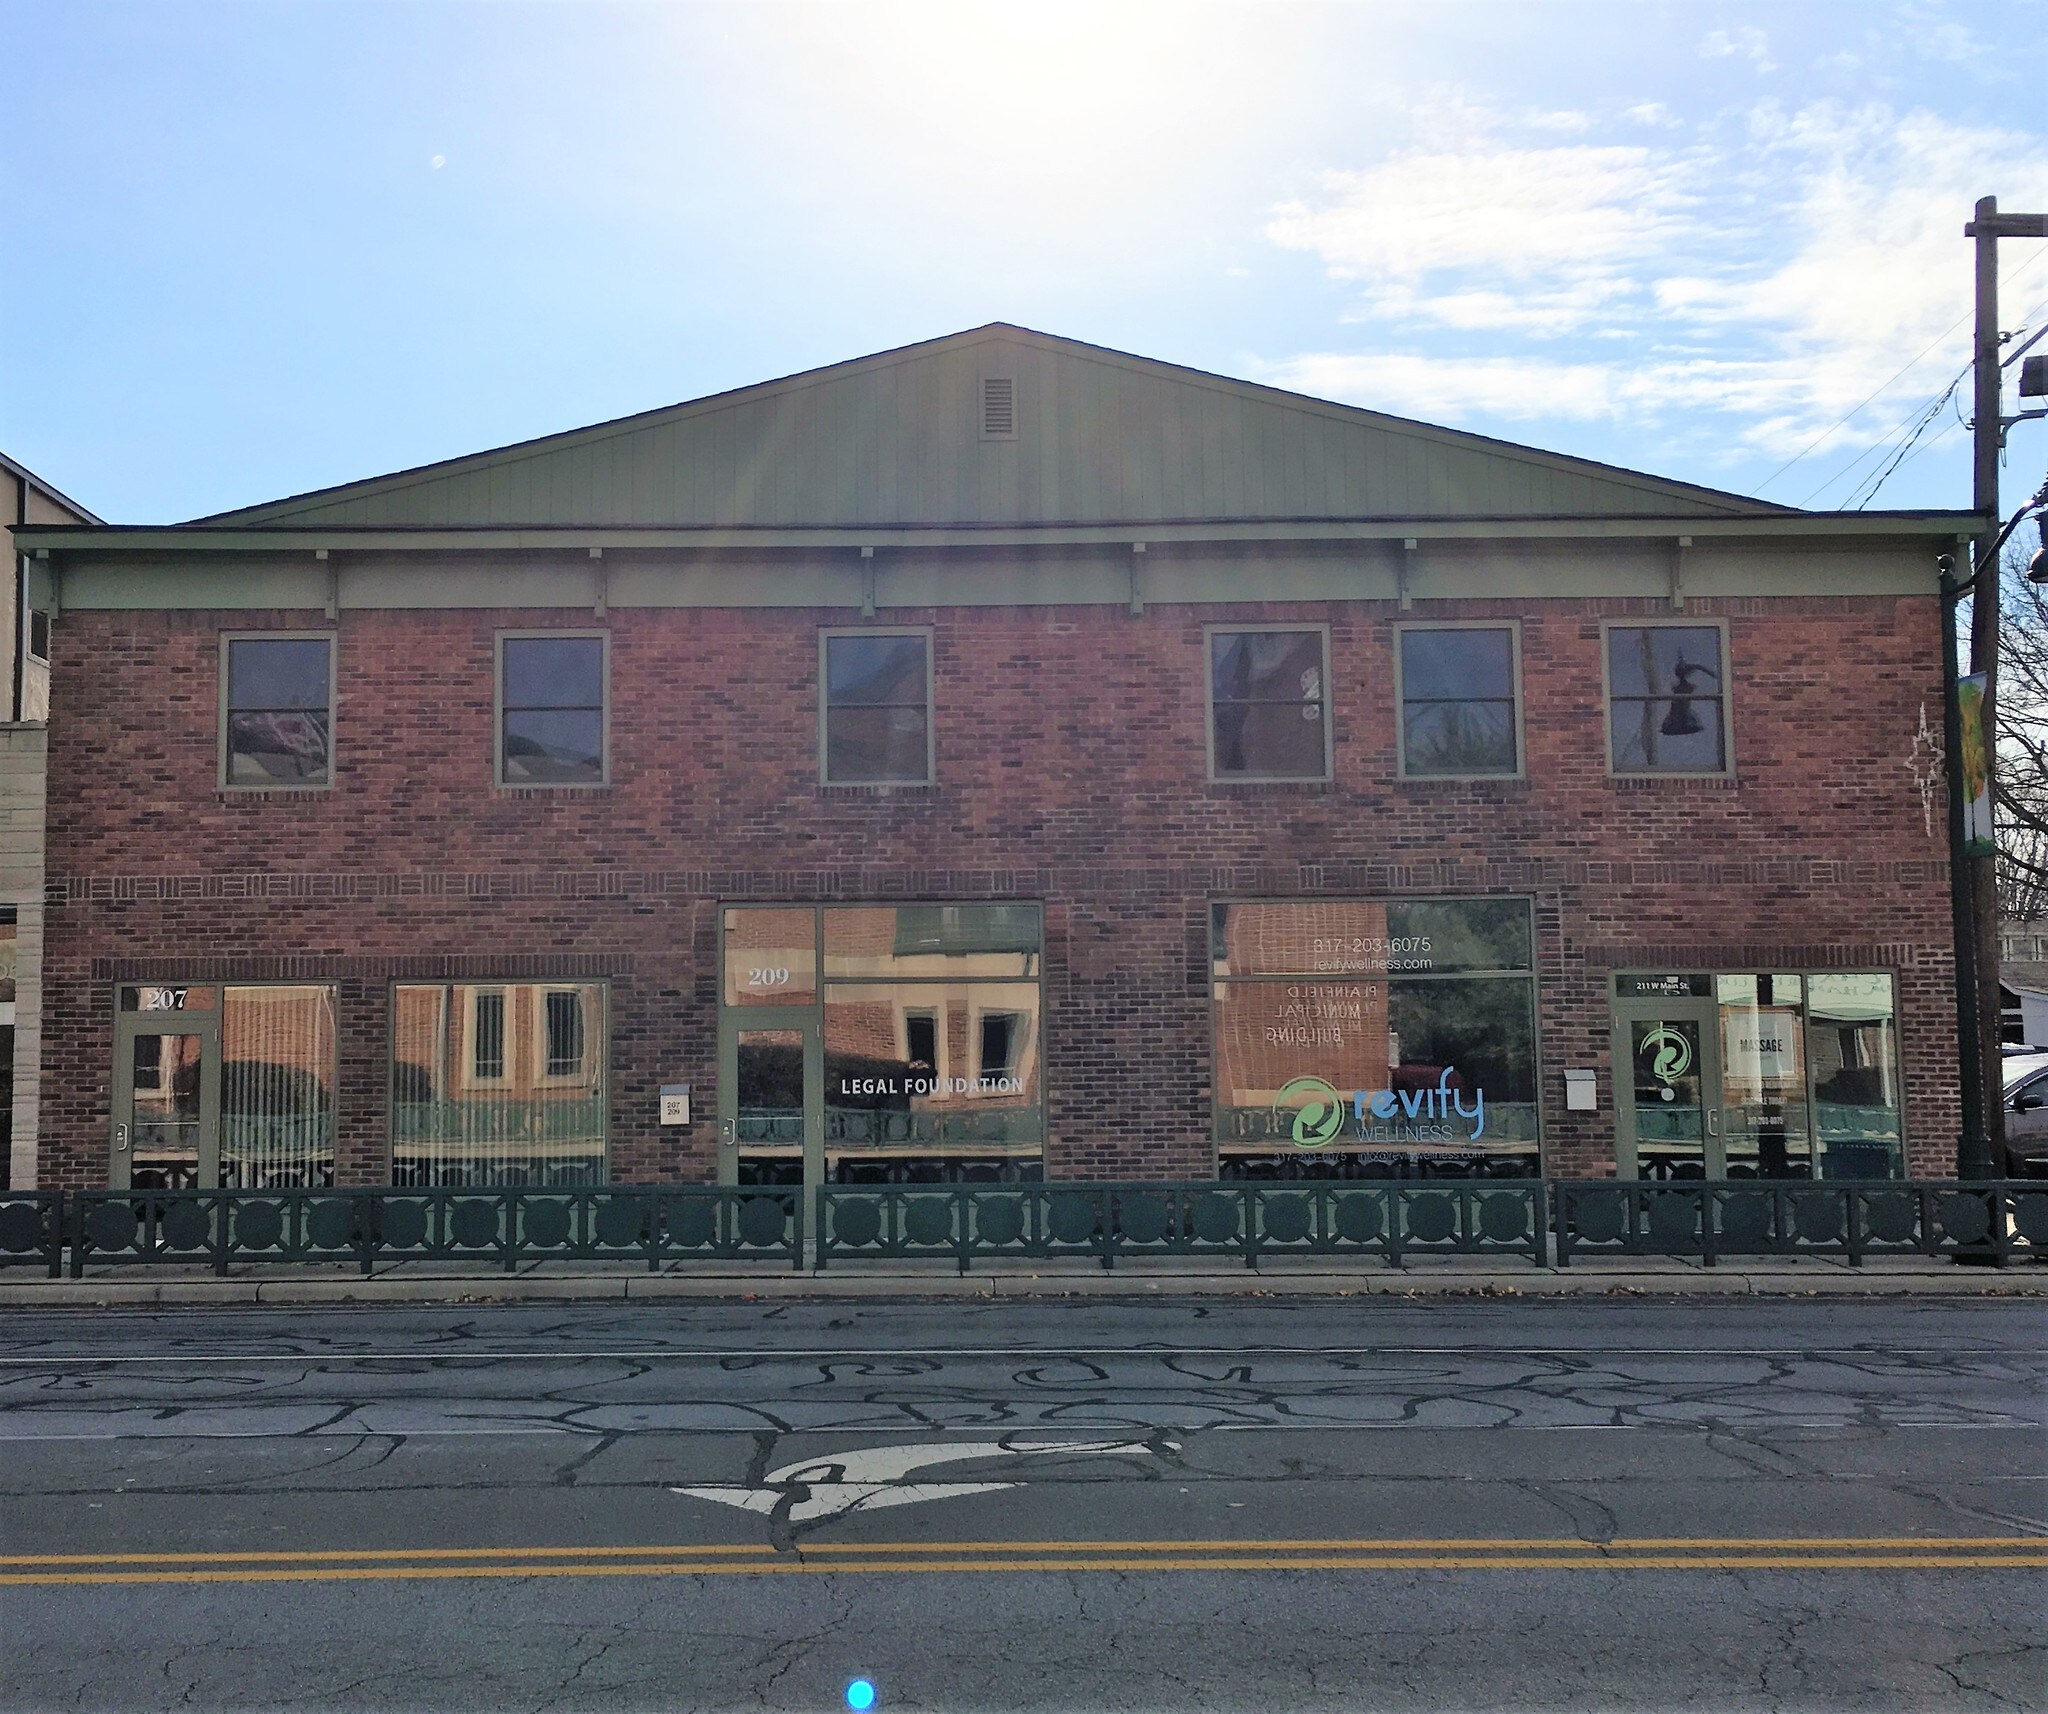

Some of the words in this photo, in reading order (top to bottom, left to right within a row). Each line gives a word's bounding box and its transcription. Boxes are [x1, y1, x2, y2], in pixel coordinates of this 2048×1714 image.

[1313, 937, 1432, 953] 317-203-6075
[1313, 957, 1433, 973] revifywellness.com
[748, 967, 790, 986] 209
[1636, 982, 1651, 990] 211
[1651, 982, 1660, 990] W
[1660, 982, 1679, 990] Main
[146, 990, 188, 1009] 207
[1740, 1039, 1783, 1052] MASSAGE
[841, 1078, 898, 1095] LEGAL
[904, 1077, 1024, 1094] FOUNDATION
[666, 1101, 681, 1109] 207
[1353, 1065, 1484, 1141] revify
[1355, 1124, 1454, 1143] WELLNESS
[1273, 1151, 1348, 1162] 317-203-6075
